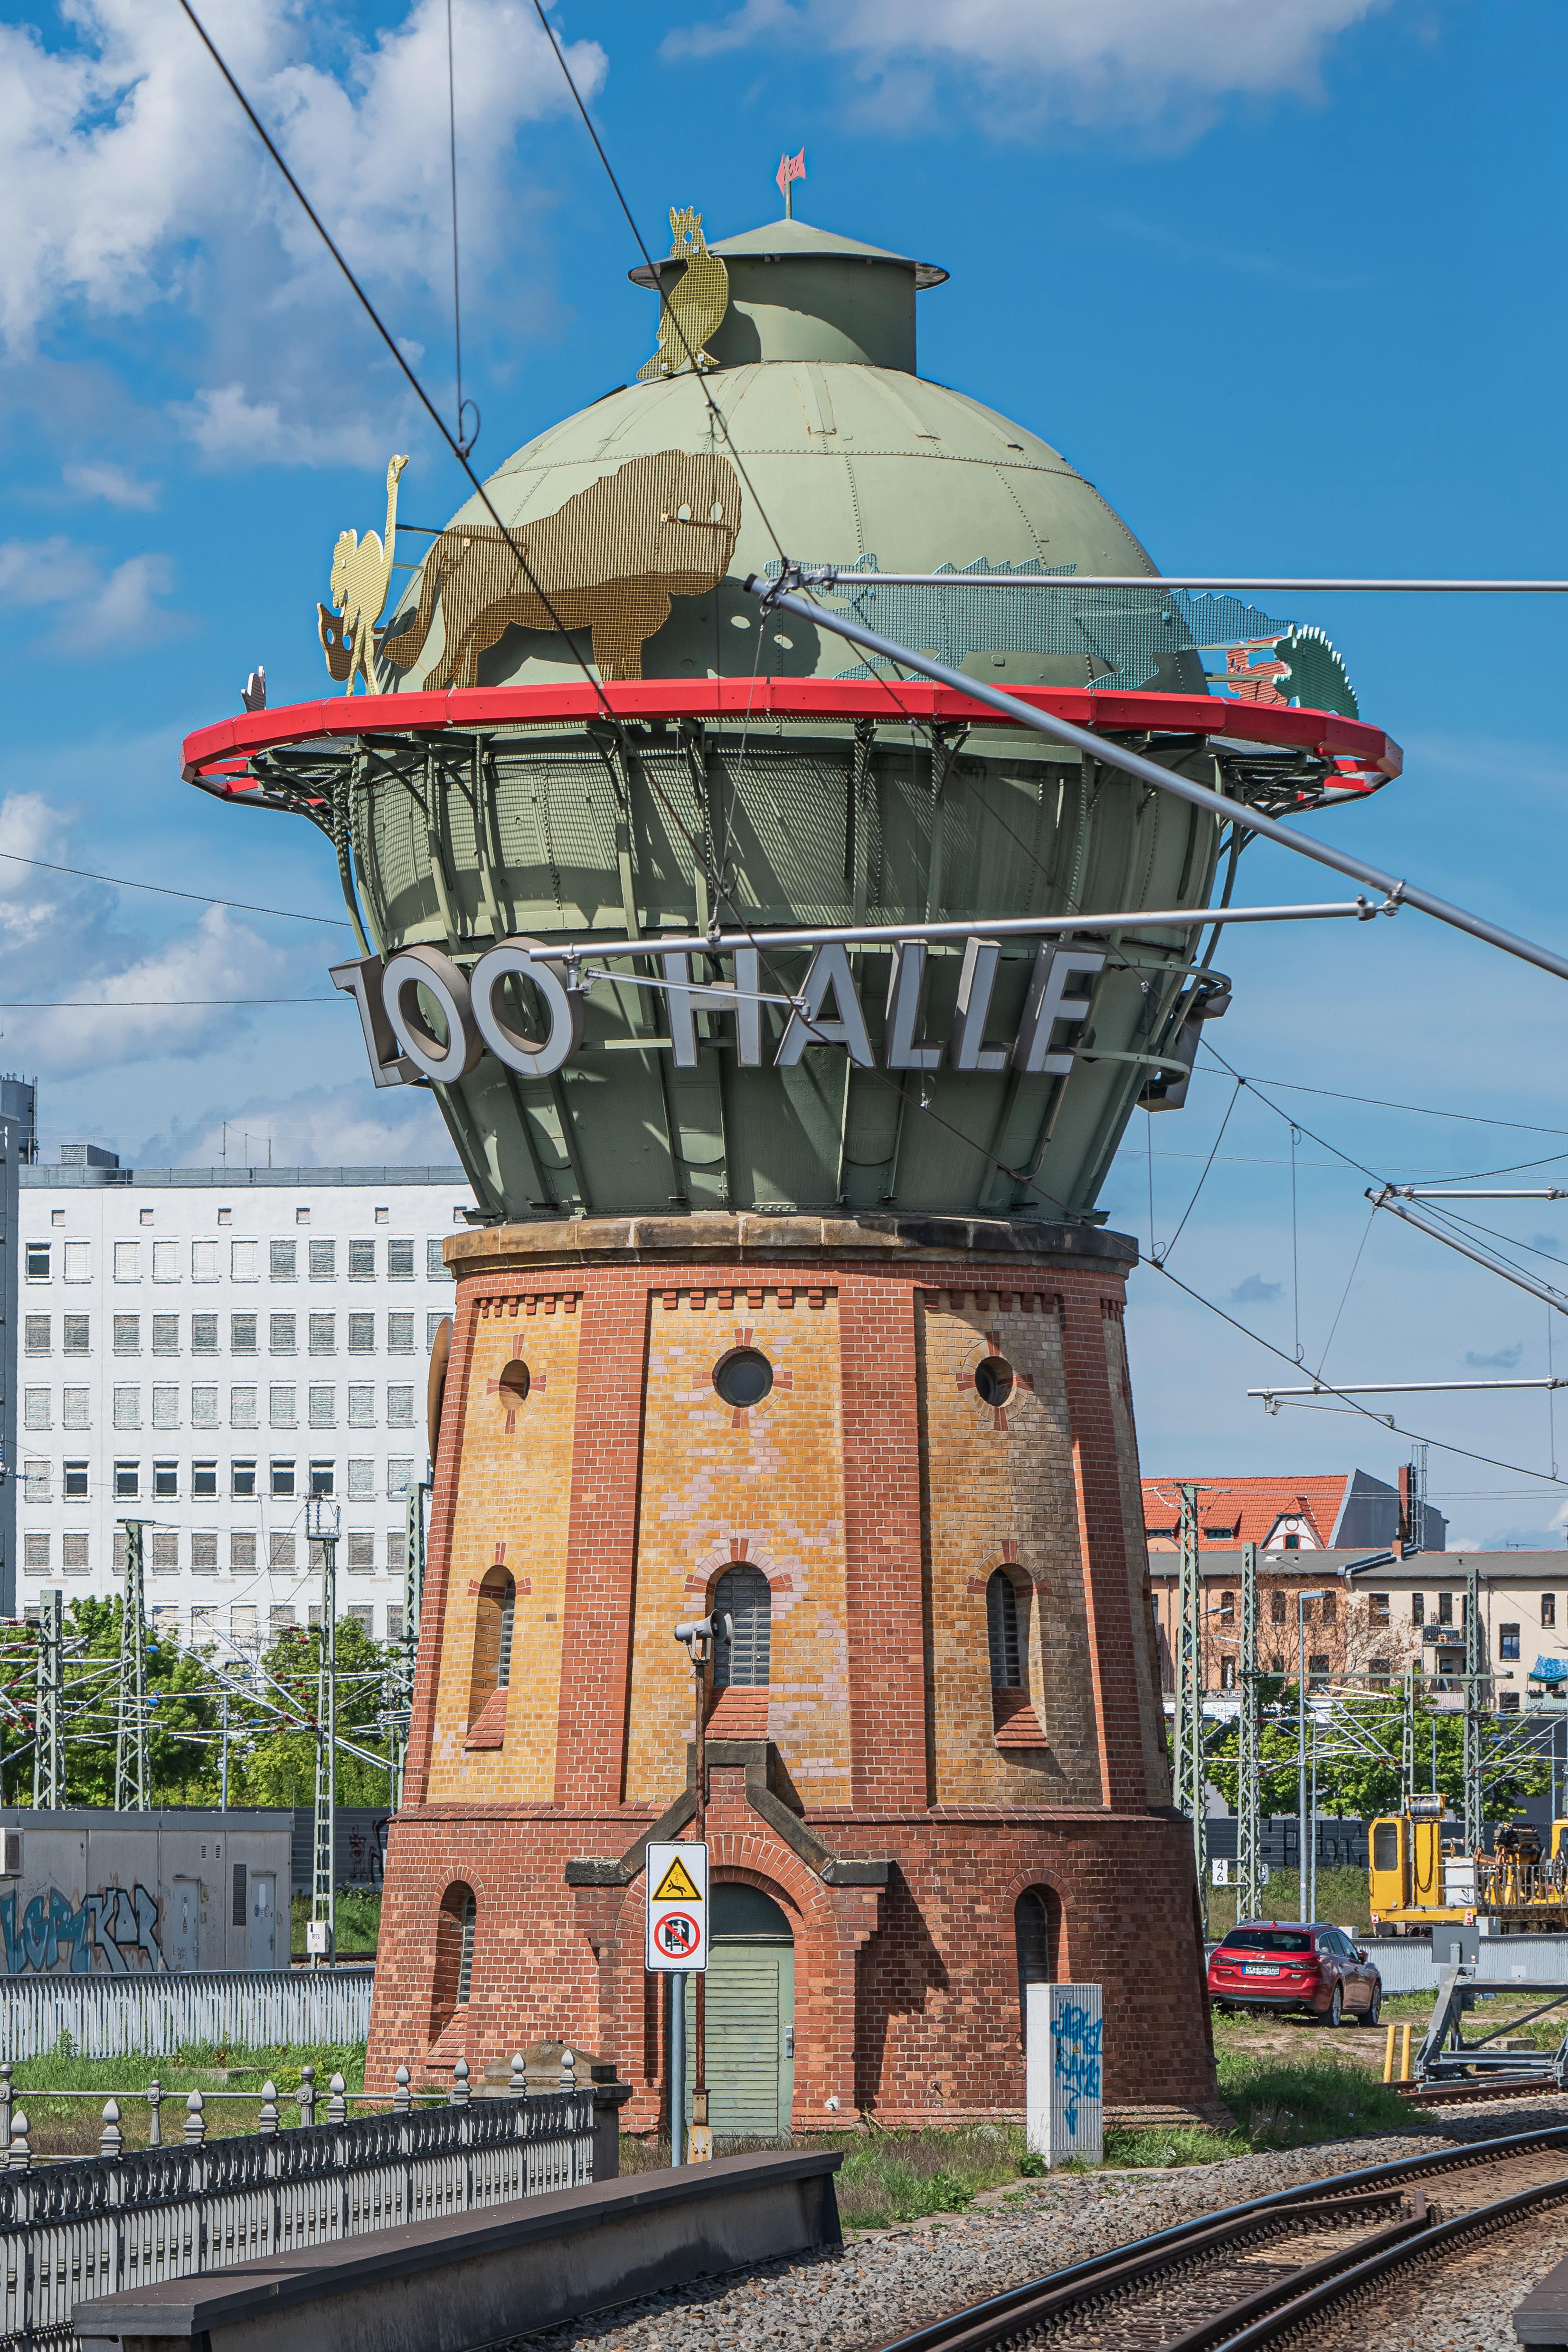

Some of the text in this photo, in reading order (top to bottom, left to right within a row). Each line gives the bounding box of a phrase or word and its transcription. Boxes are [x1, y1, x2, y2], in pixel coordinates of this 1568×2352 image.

[662, 935, 1107, 1074] HALLE
[1218, 1860, 1223, 1871] 4
[1217, 1872, 1223, 1881] 6
